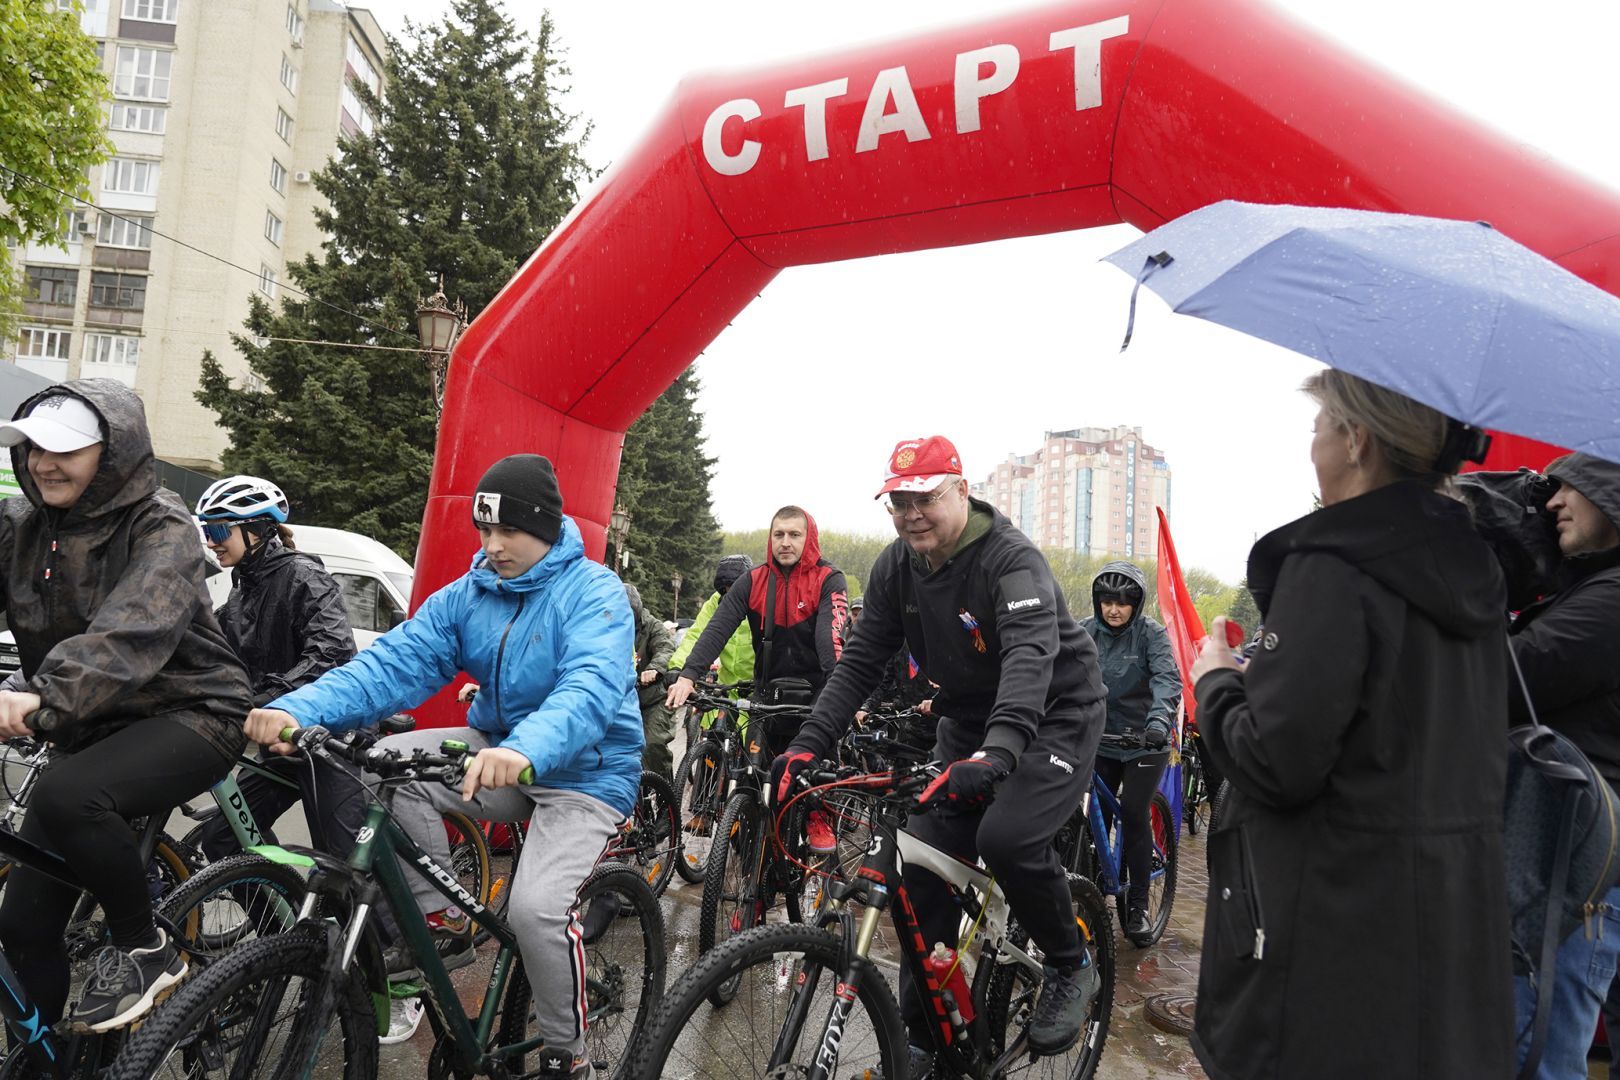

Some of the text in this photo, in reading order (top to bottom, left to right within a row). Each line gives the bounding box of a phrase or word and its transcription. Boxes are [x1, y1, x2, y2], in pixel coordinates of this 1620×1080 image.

[702, 15, 1129, 176] СТАРТ
[1007, 598, 1041, 611] Kempa
[417, 855, 485, 913] HORH
[816, 1002, 850, 1075] FOX
